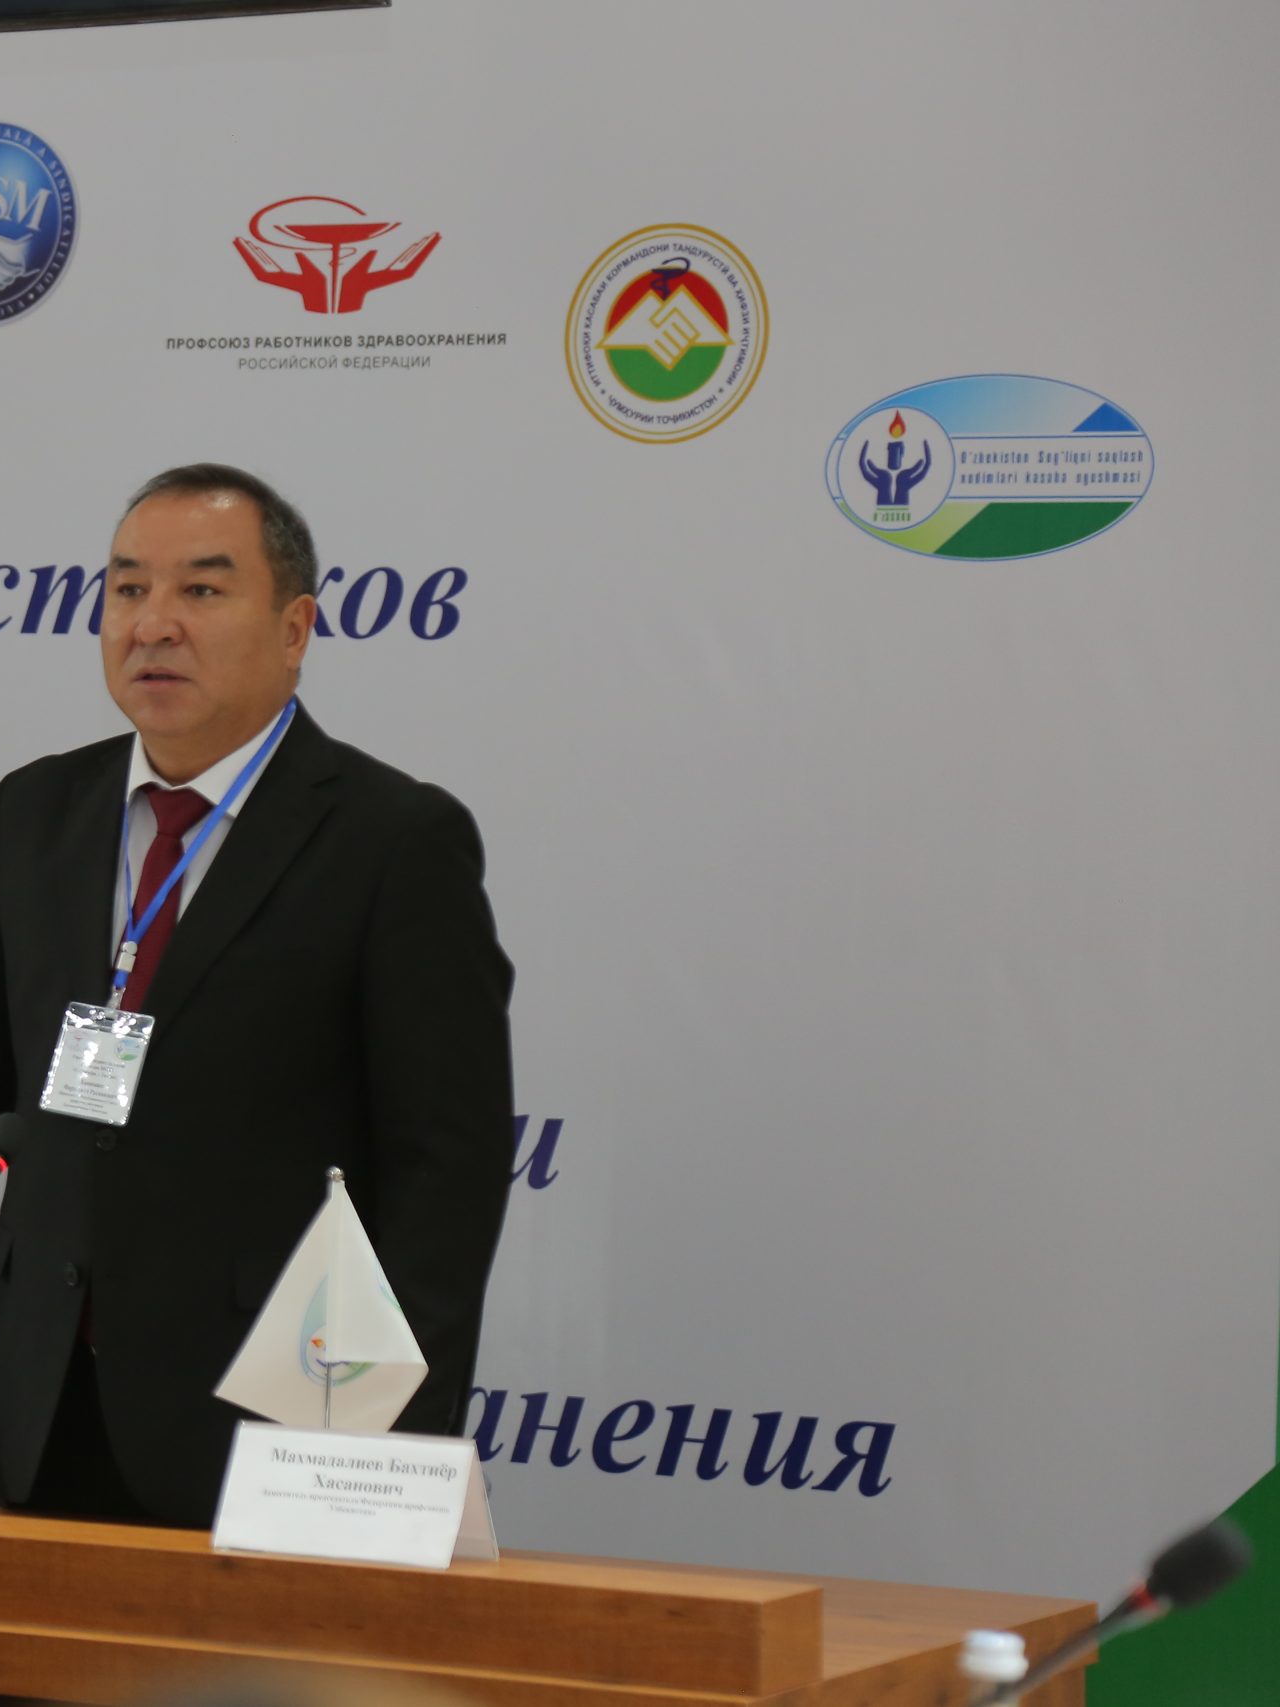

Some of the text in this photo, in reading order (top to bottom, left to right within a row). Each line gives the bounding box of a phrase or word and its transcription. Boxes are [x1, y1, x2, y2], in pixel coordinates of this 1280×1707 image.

[166, 333, 507, 350] ПРОФСОЮЗ РАБОТНИКОВ ЗДРАВООХРАНЕНИЯ
[238, 355, 432, 370] РОССИЙСКОЙ ФЕДЕРАЦИИ
[271, 1448, 457, 1482] Махмадалиев Бахтиёр
[312, 1473, 404, 1496] Хасанович
